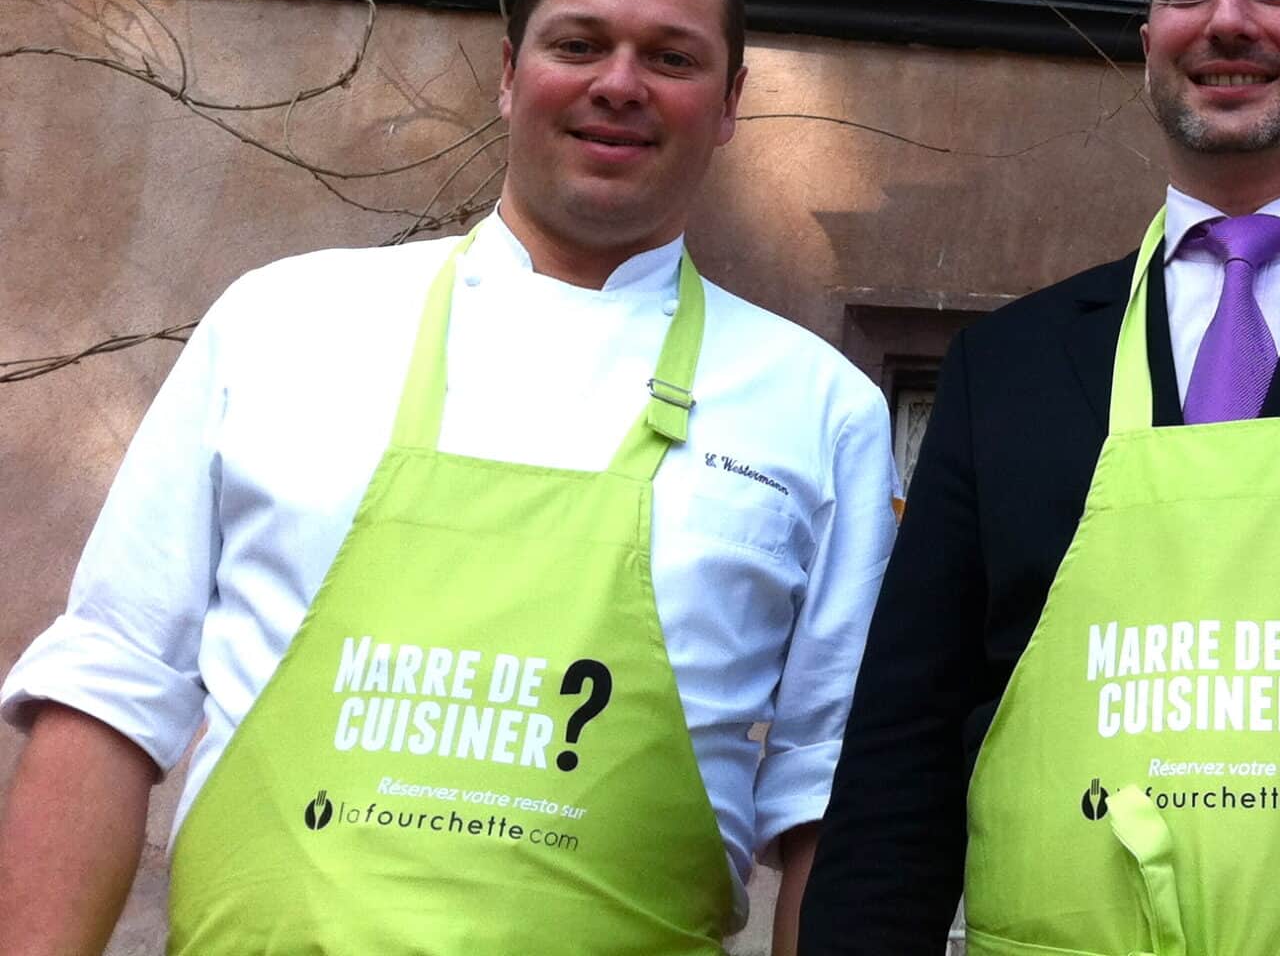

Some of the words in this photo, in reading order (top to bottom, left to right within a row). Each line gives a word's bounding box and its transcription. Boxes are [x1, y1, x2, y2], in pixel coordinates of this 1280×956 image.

[487, 653, 547, 708] DE
[333, 696, 554, 770] CUISINER
[1228, 761, 1277, 777] votre
[462, 788, 511, 808] votre
[513, 796, 559, 815] resto
[561, 804, 588, 820] sur
